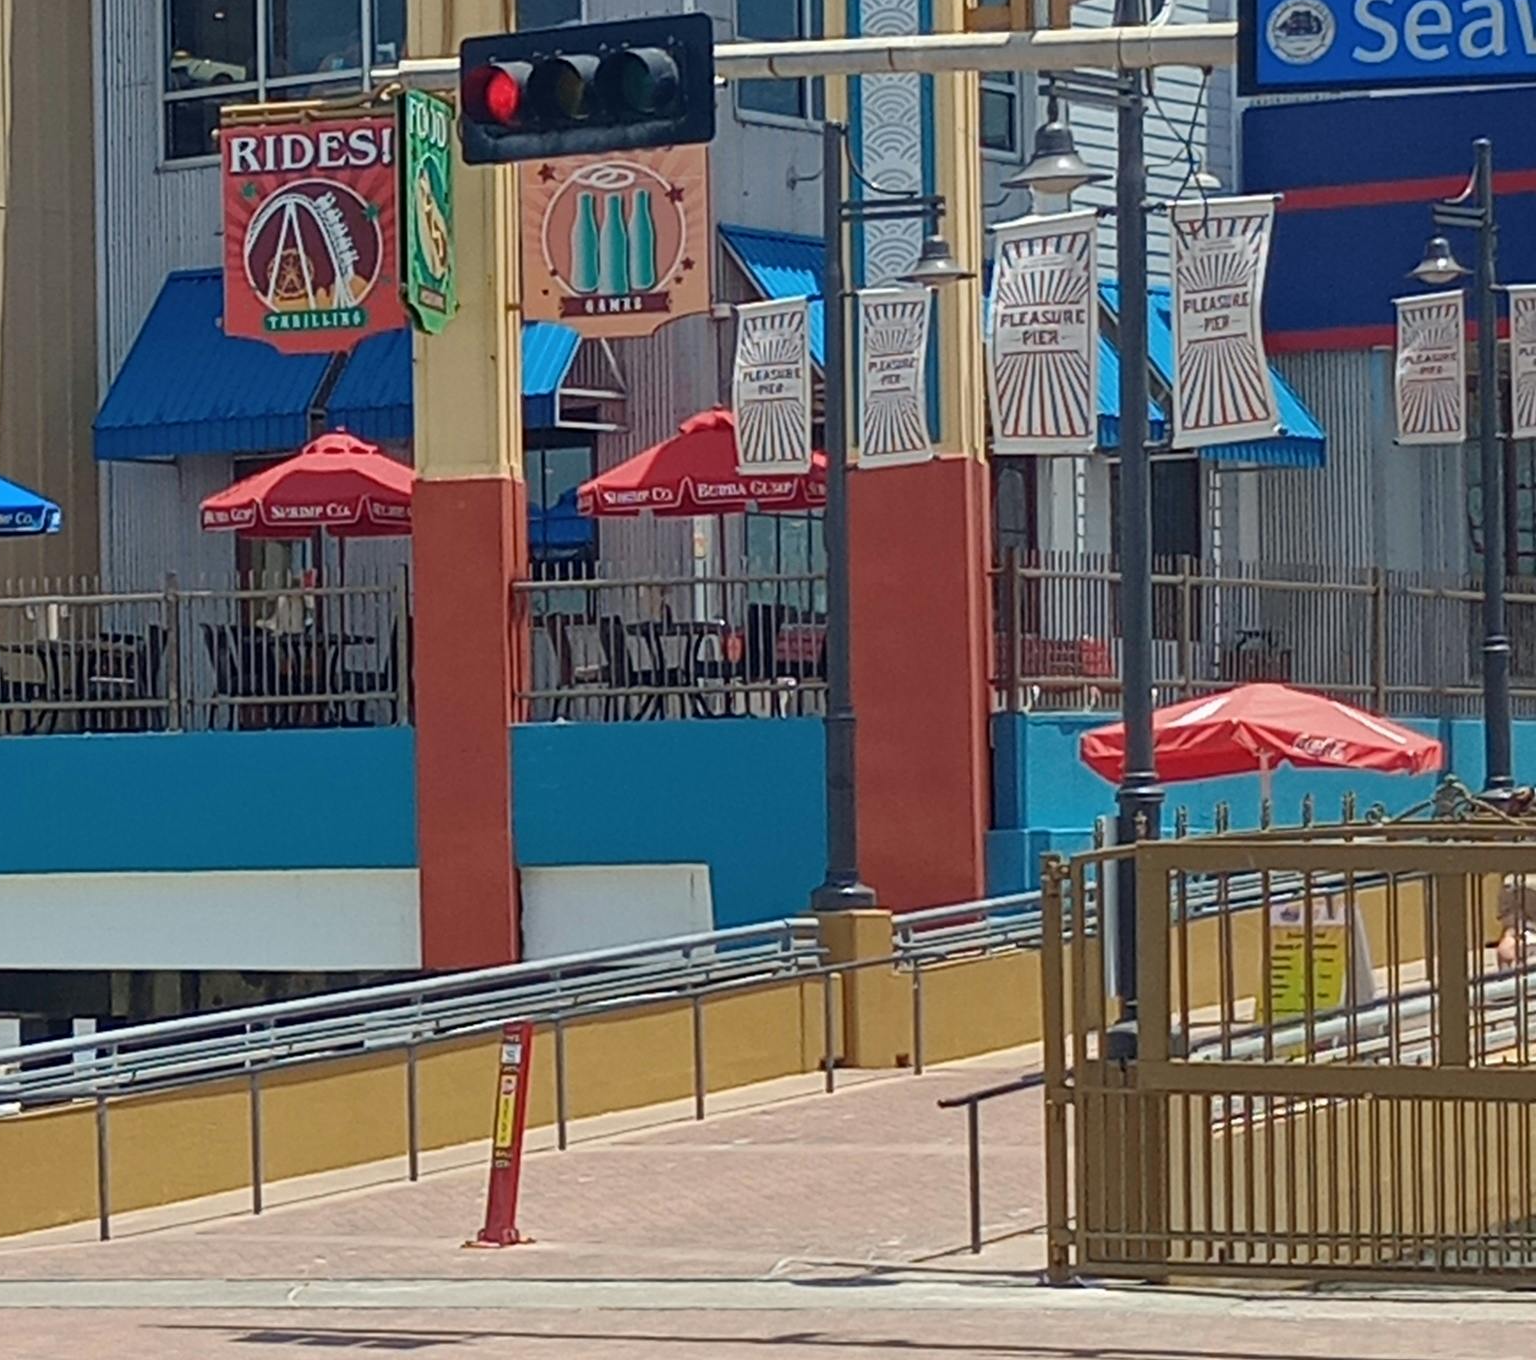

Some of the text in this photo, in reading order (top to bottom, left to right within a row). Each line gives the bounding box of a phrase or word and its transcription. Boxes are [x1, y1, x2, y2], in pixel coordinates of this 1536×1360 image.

[407, 97, 449, 149] FOOD
[229, 127, 395, 174] RIDES!
[1183, 292, 1249, 313] PLEASURE
[266, 310, 362, 330] THRILLING
[1000, 309, 1086, 327] PLEASURE
[1203, 313, 1230, 331] PIER
[1021, 329, 1060, 345] PIER
[742, 367, 802, 383] PLEASURE
